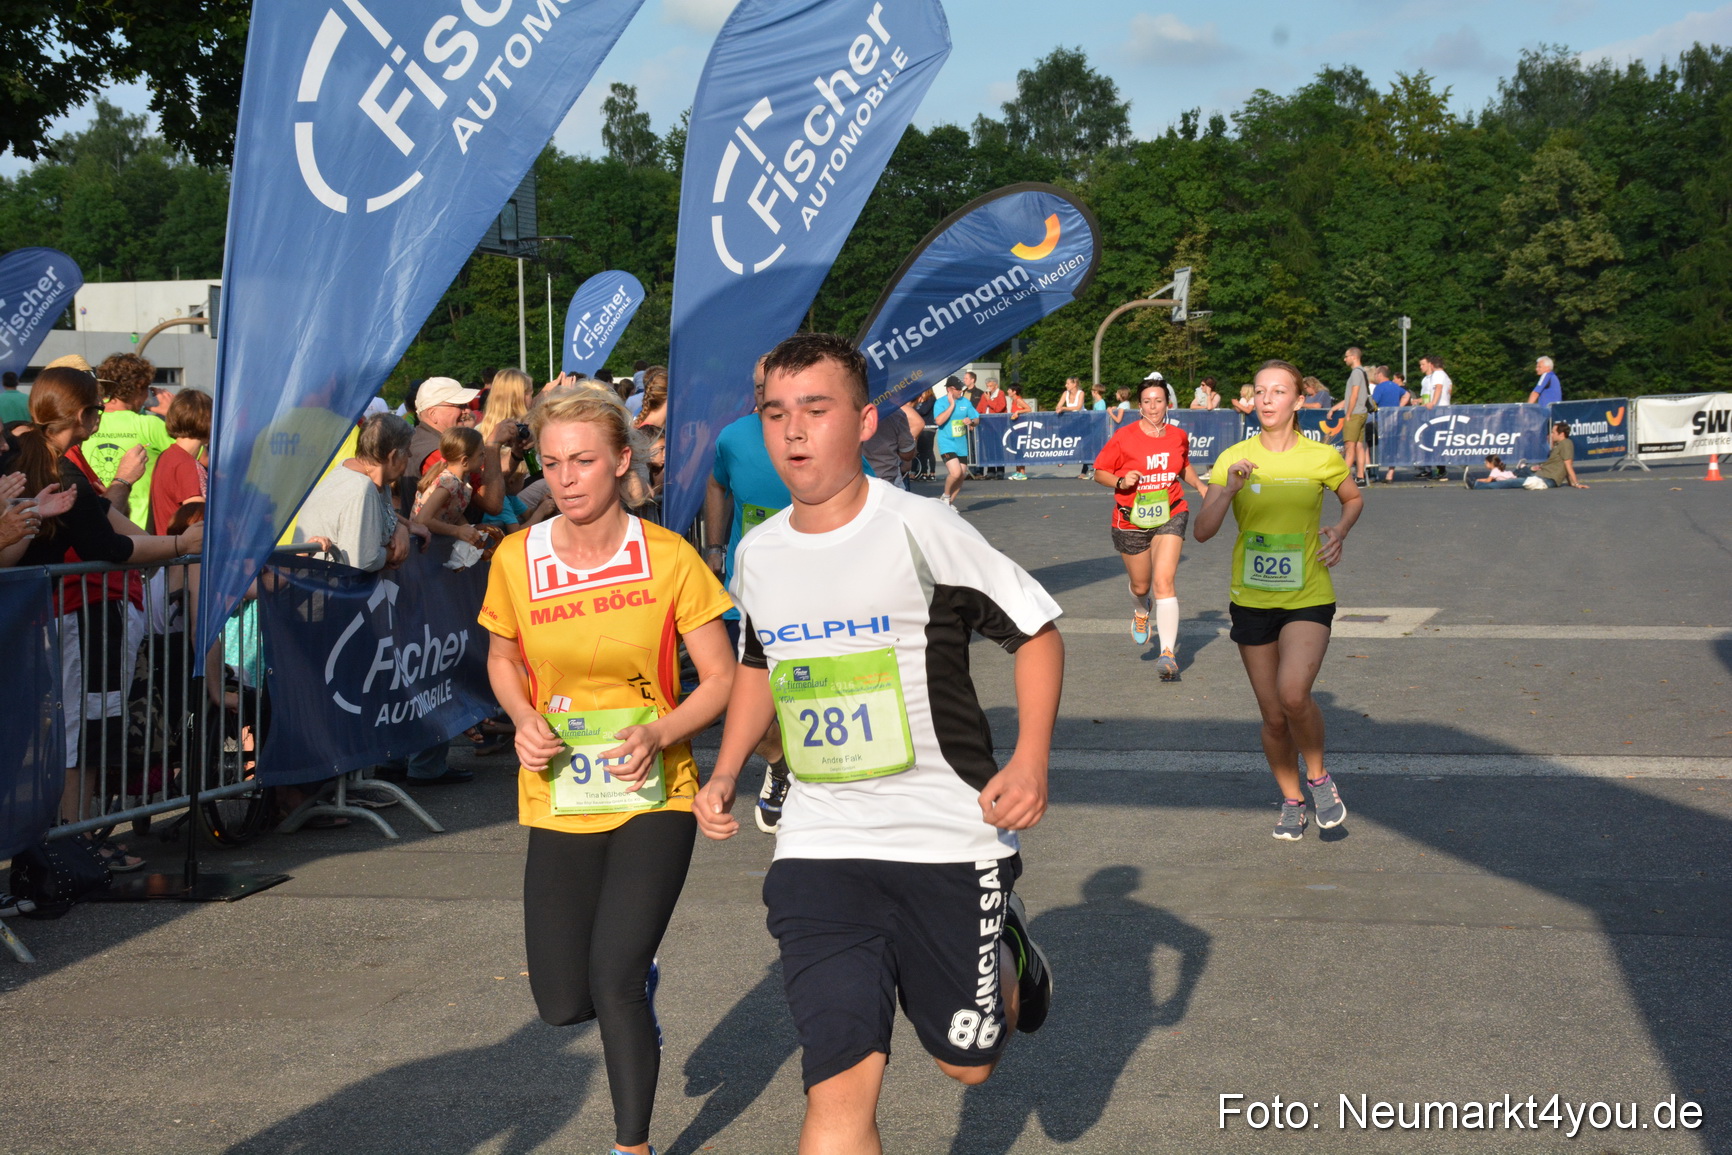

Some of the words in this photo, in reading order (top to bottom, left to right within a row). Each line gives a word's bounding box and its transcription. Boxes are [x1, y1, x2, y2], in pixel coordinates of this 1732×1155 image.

[451, 0, 571, 155] AUTOM
[747, 1, 892, 235] Fischer
[800, 46, 910, 231] AUTOMOBILE
[973, 298, 1013, 326] Druck
[1013, 283, 1039, 301] und
[1038, 252, 1086, 290] Medien
[17, 280, 66, 346] AUTOMOBILE
[583, 285, 629, 349] Fischer
[598, 296, 633, 348] AUTOMOBILE
[866, 264, 1031, 370] Frischmann
[872, 369, 925, 407] ann-net.de
[1433, 429, 1522, 447] Fischer
[1692, 409, 1732, 436] SW
[1016, 433, 1082, 450] Fischer
[1022, 449, 1075, 458] AUTOMOBILE
[1441, 447, 1514, 457] AUTOMOBILE
[1138, 505, 1163, 519] 949
[1253, 555, 1292, 575] 626
[530, 600, 586, 626] MAX
[592, 589, 657, 614] BÖGL
[756, 615, 891, 646] DELPHI
[787, 678, 828, 689] firmenlauf
[561, 728, 601, 738] firmenlauf
[799, 703, 874, 747] 281
[570, 752, 633, 785] 91
[821, 756, 844, 764] Andre
[844, 754, 863, 763] Falk
[947, 1008, 1002, 1050] 86
